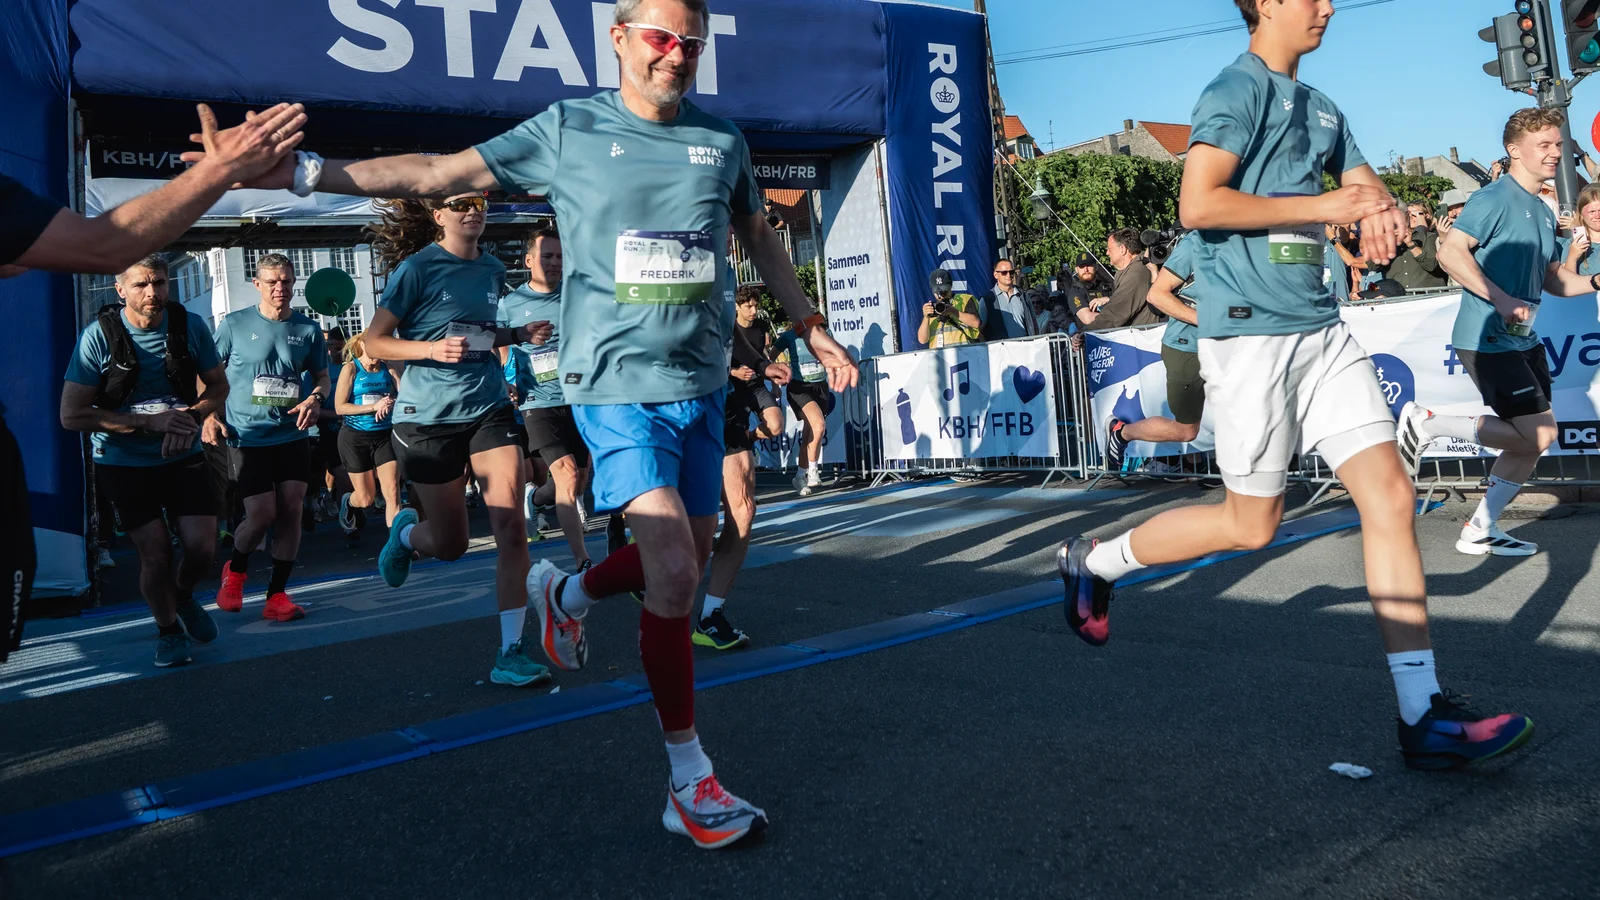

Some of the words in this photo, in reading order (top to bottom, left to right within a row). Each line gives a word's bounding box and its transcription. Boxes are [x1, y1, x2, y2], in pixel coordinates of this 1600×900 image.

[928, 42, 963, 209] ROYAL
[103, 150, 196, 170] KBH/F
[687, 146, 725, 159] ROYAL
[753, 164, 817, 180] KBH/FRB
[936, 225, 968, 291] RU
[1280, 245, 1290, 257] C
[1306, 246, 1312, 257] 5
[827, 253, 870, 270] Sammen
[640, 269, 695, 279] FREDERIK
[828, 277, 845, 291] kan
[847, 274, 857, 289] vi
[628, 286, 640, 298] C
[665, 286, 671, 298] 1
[830, 298, 856, 312] mere,
[859, 292, 880, 308] end
[832, 319, 842, 332] vi
